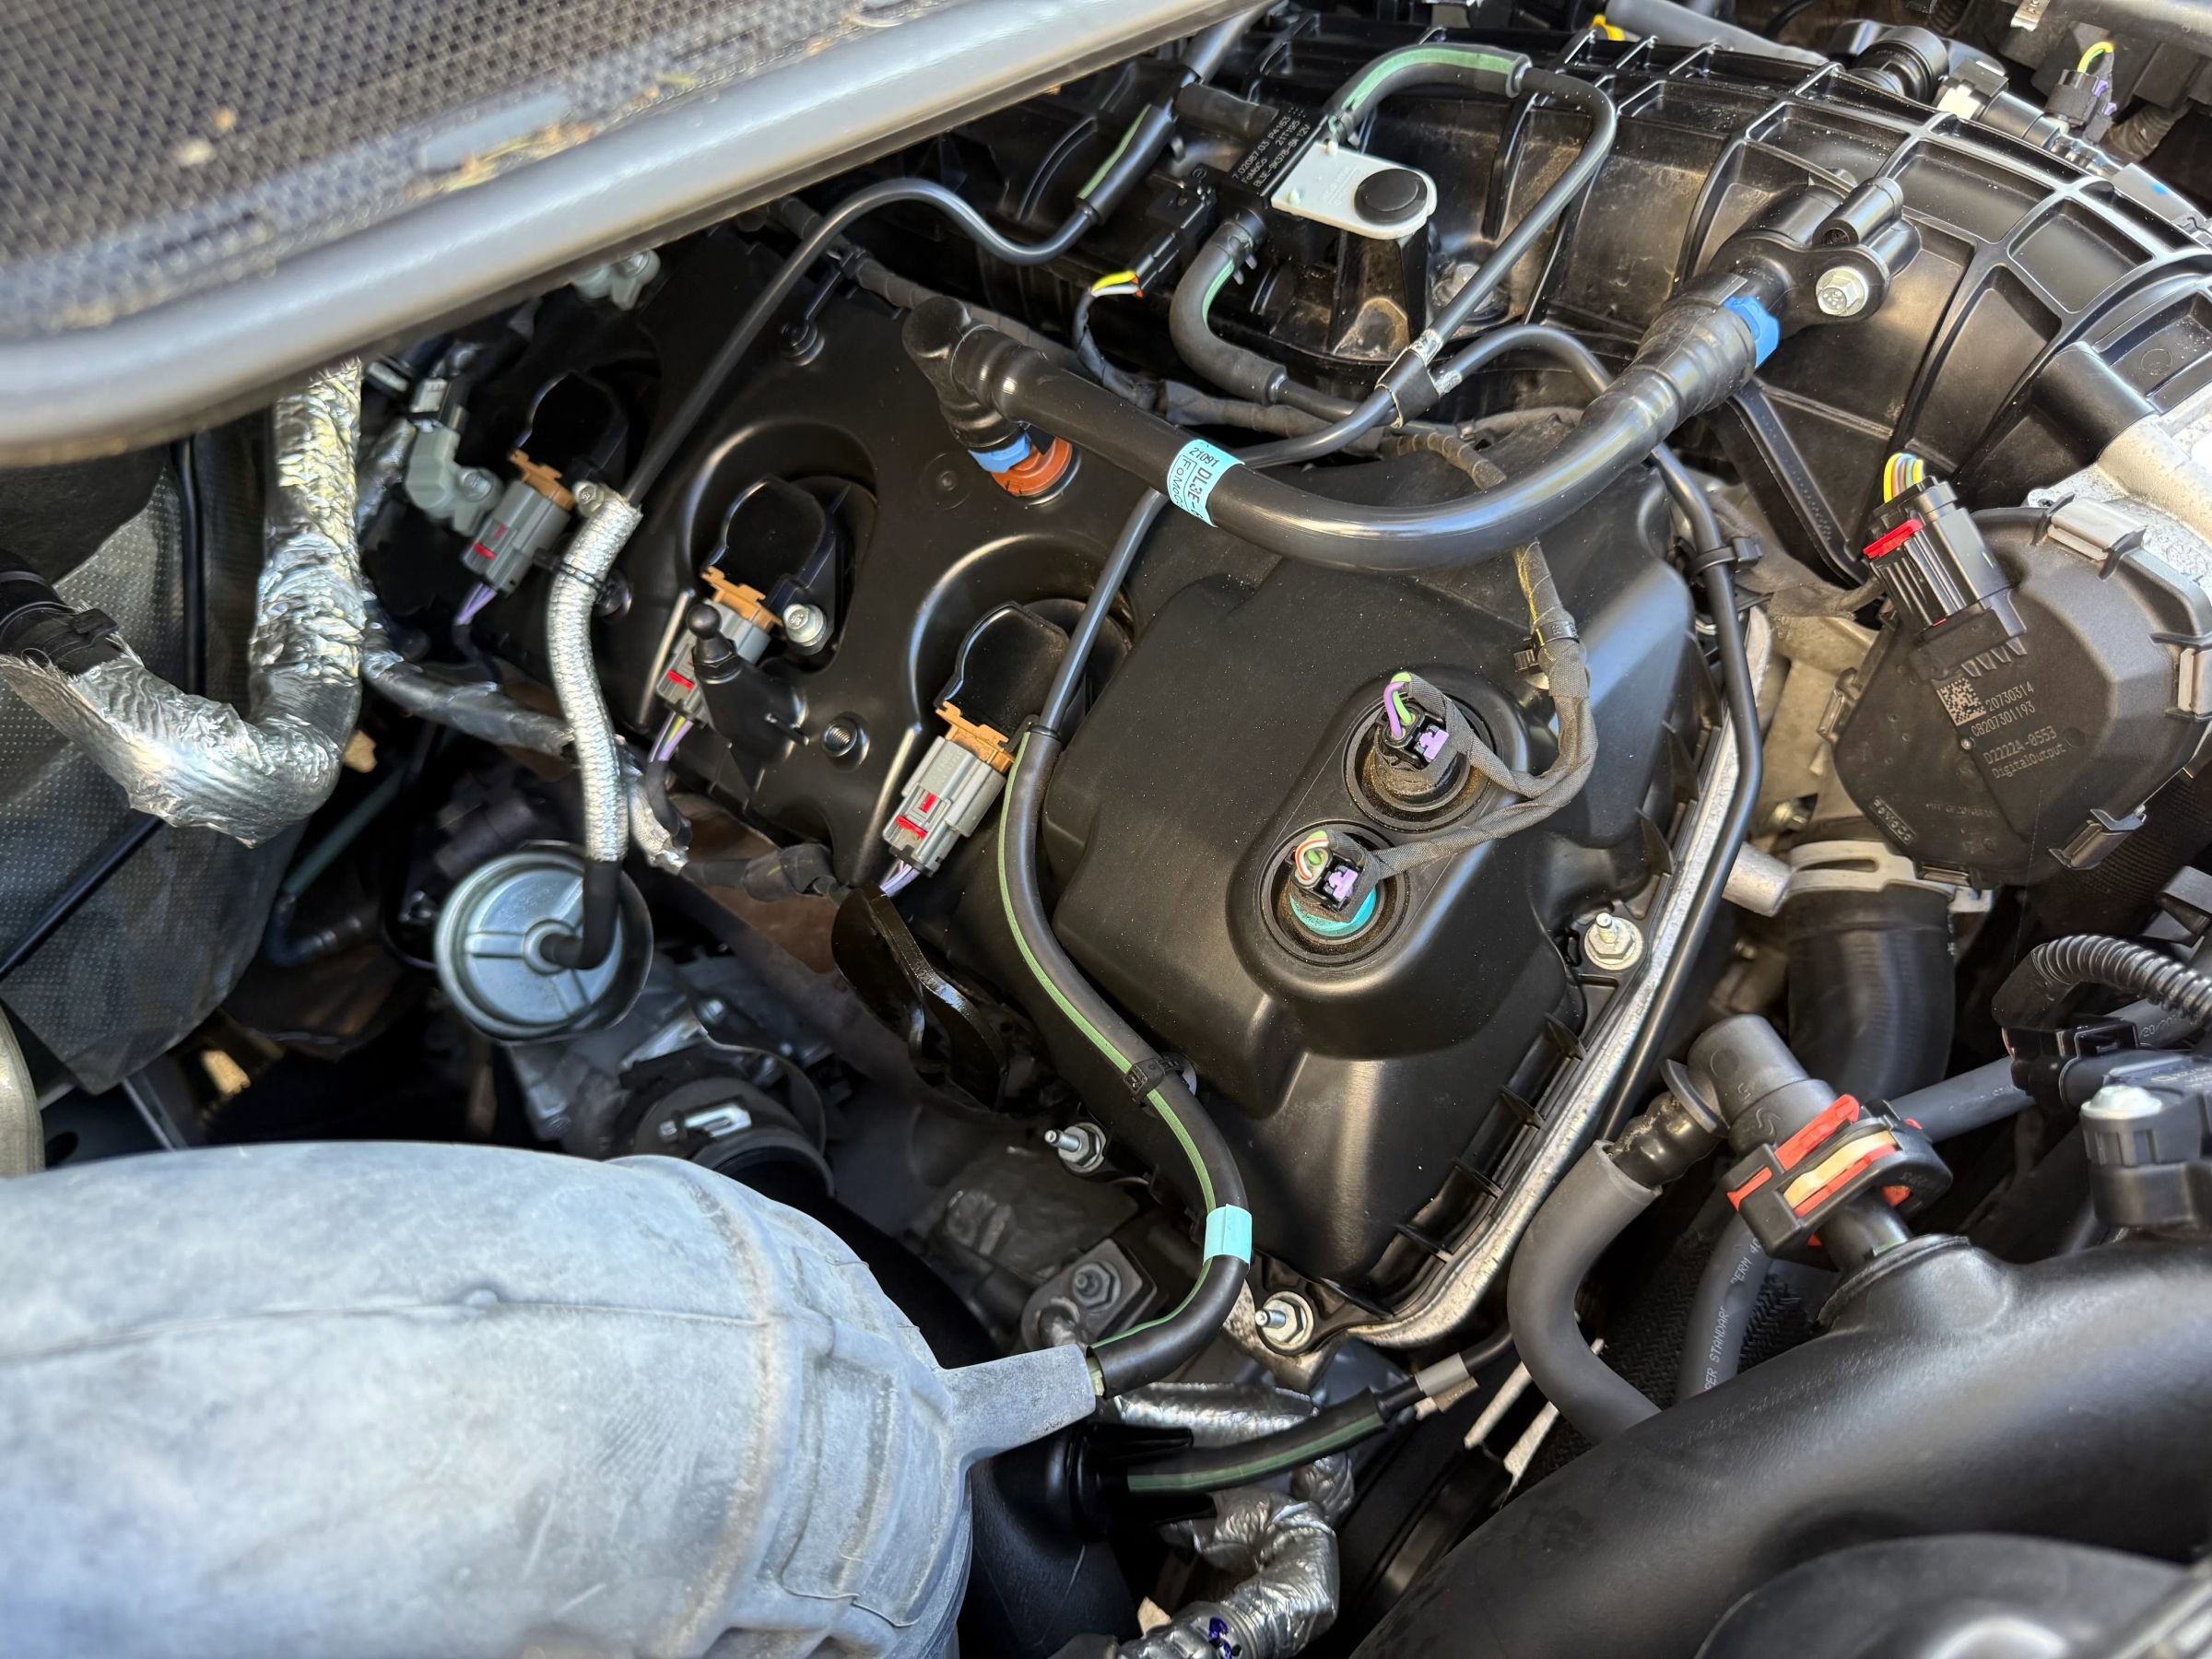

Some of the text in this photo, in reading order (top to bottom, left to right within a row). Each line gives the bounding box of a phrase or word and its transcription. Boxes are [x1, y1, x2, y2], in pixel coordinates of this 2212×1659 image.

[1241, 158, 1267, 183] FoMoCo
[1189, 447, 1220, 467] 21091
[1171, 458, 1192, 509] FoMoC
[1985, 681, 2034, 712] 20730314
[1971, 700, 2036, 737] CB207301193
[1983, 725, 2057, 765] D2222A-0553
[1992, 743, 2066, 779] DigitalOutput
